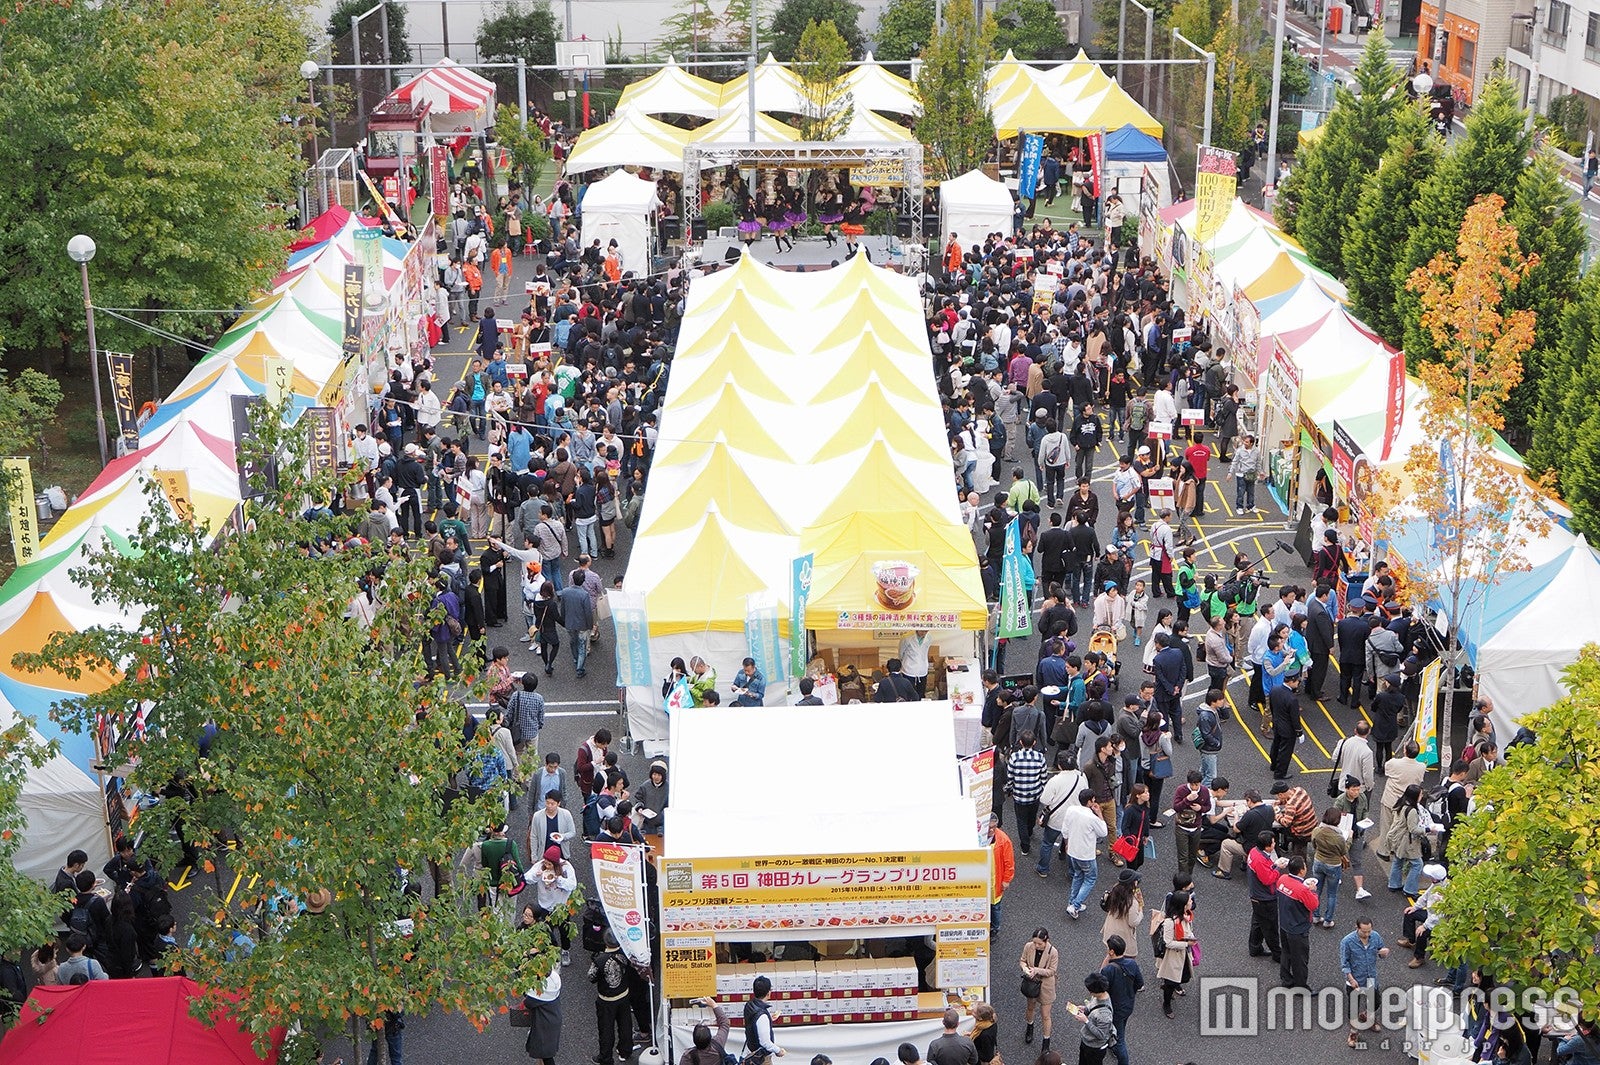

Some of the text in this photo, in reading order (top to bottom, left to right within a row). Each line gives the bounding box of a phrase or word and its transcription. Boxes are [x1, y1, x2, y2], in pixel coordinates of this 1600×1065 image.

[757, 867, 957, 888] 神田カレーグランプリ2015
[666, 949, 706, 962] 投票場
